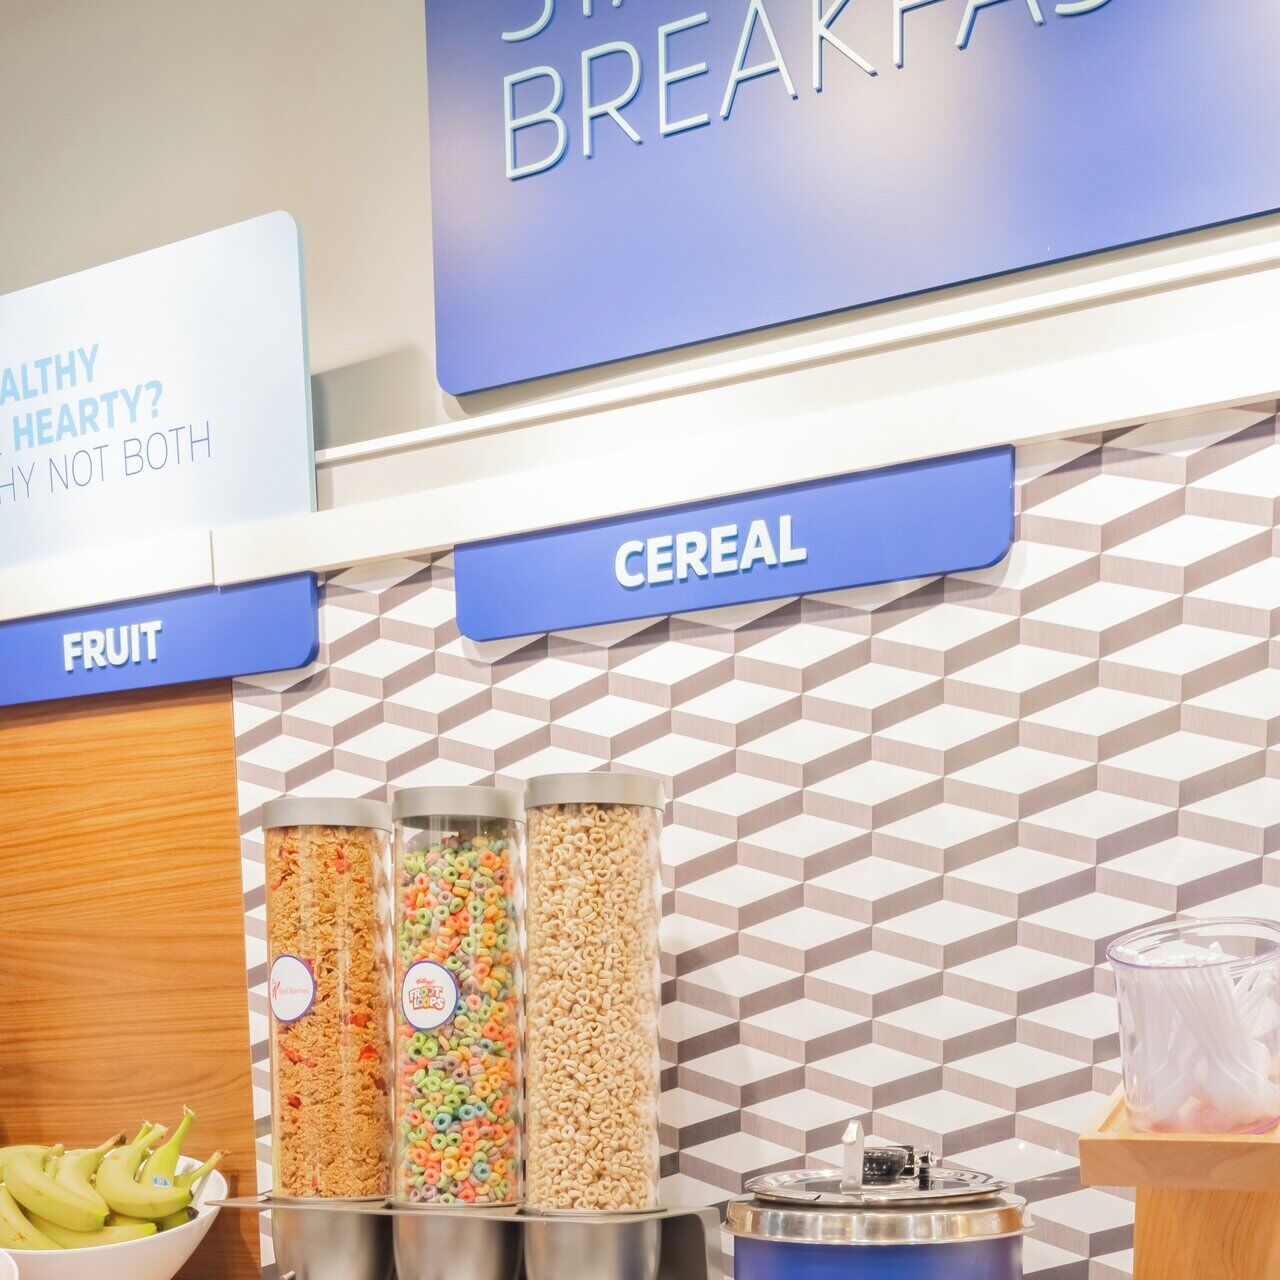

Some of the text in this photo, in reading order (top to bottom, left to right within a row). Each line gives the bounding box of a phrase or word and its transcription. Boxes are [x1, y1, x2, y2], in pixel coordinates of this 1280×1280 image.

[504, 0, 1112, 180] BREAKF
[13, 380, 163, 452] HEARTY?
[49, 445, 109, 493] NOT
[124, 420, 211, 476] BOTH
[615, 514, 808, 589] CEREAL
[63, 621, 163, 673] FRUIT
